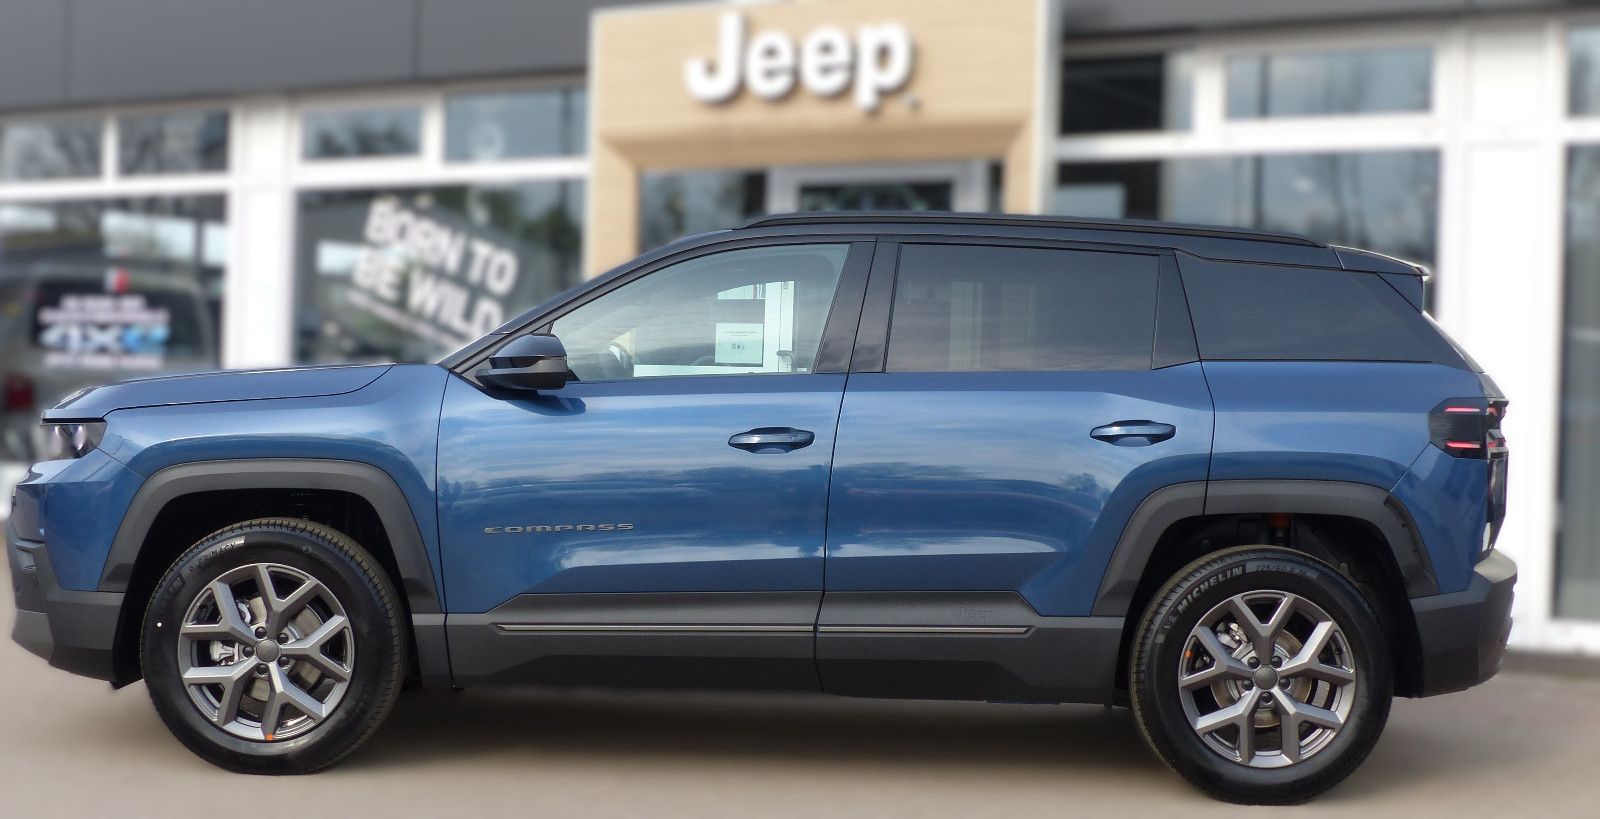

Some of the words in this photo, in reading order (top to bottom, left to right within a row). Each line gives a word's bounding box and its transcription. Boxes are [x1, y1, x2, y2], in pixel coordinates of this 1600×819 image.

[683, 10, 913, 111] Jeep
[364, 196, 466, 276] BORN
[466, 239, 519, 297] TO
[352, 247, 403, 302] BE
[407, 266, 505, 339] WILD
[483, 522, 635, 535] COMPASS
[1177, 565, 1244, 615] MICHELIN
